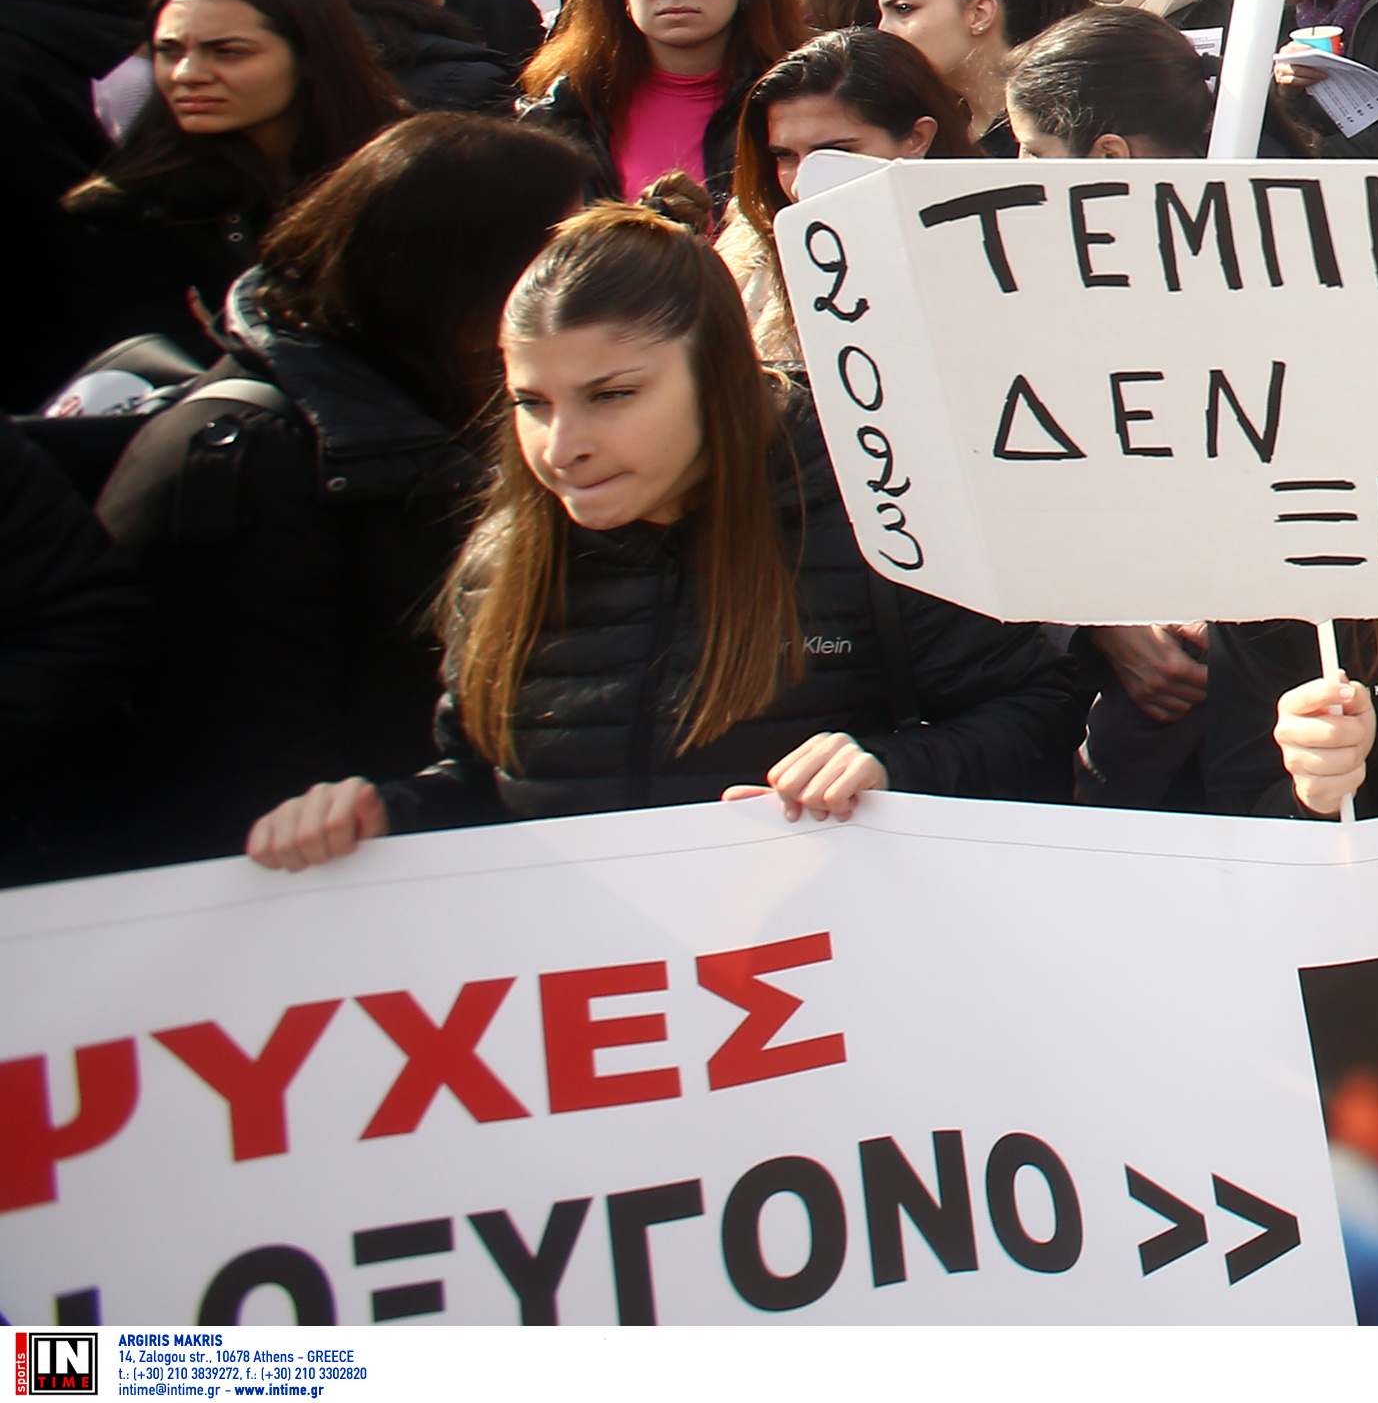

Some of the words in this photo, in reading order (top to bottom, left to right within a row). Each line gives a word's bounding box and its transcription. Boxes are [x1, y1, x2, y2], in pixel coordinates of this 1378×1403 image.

[804, 220, 924, 571] 2023
[992, 361, 1285, 464] ΔΕΝ
[802, 636, 852, 655] Klein
[0, 930, 848, 1215] ΨΥΧΕΣ
